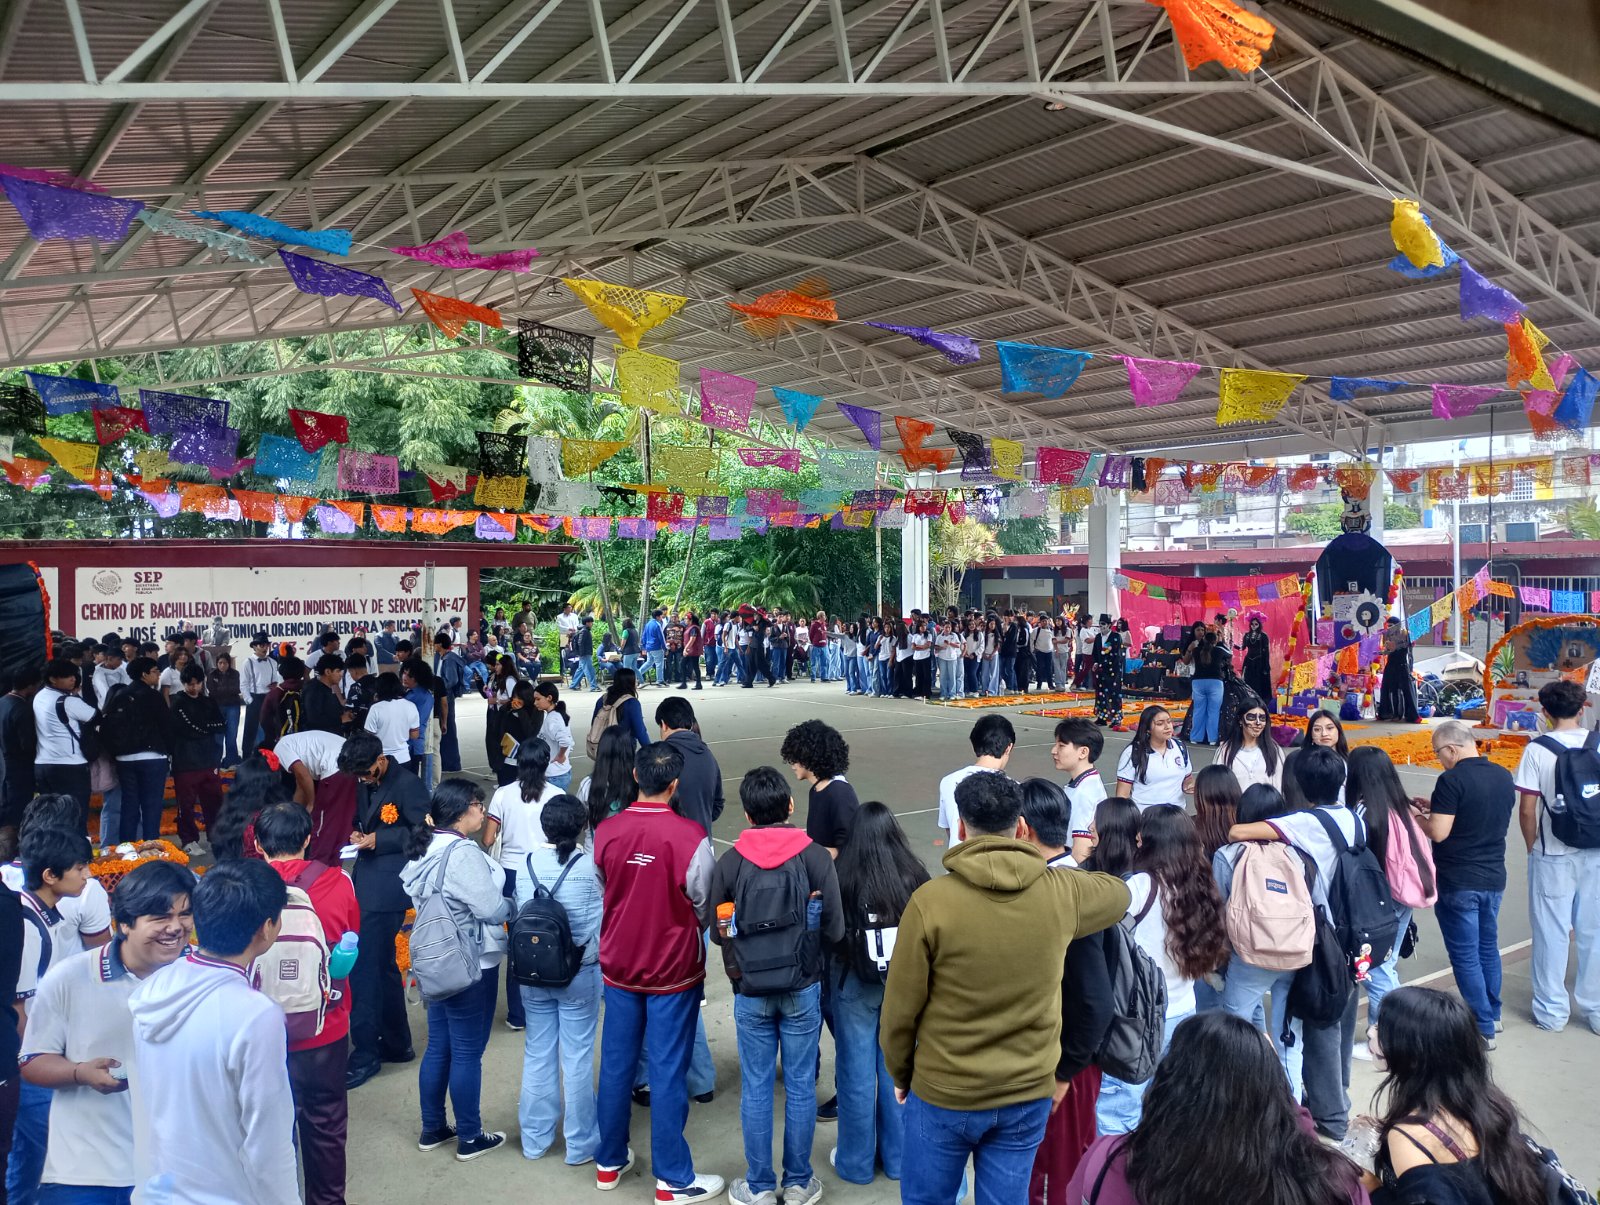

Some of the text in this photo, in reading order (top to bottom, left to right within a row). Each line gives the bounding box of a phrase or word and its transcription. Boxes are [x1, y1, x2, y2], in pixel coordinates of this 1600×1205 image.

[134, 571, 163, 583] SEP
[81, 603, 127, 620] CENTRO
[131, 603, 145, 619] DE
[150, 602, 228, 619] BACHILLERATO
[231, 597, 300, 617] TECNOLÓGICO
[303, 599, 358, 615] INDUSTRIAL
[359, 599, 368, 614] Y
[371, 599, 384, 614] DE
[129, 622, 157, 642] JOSÉ
